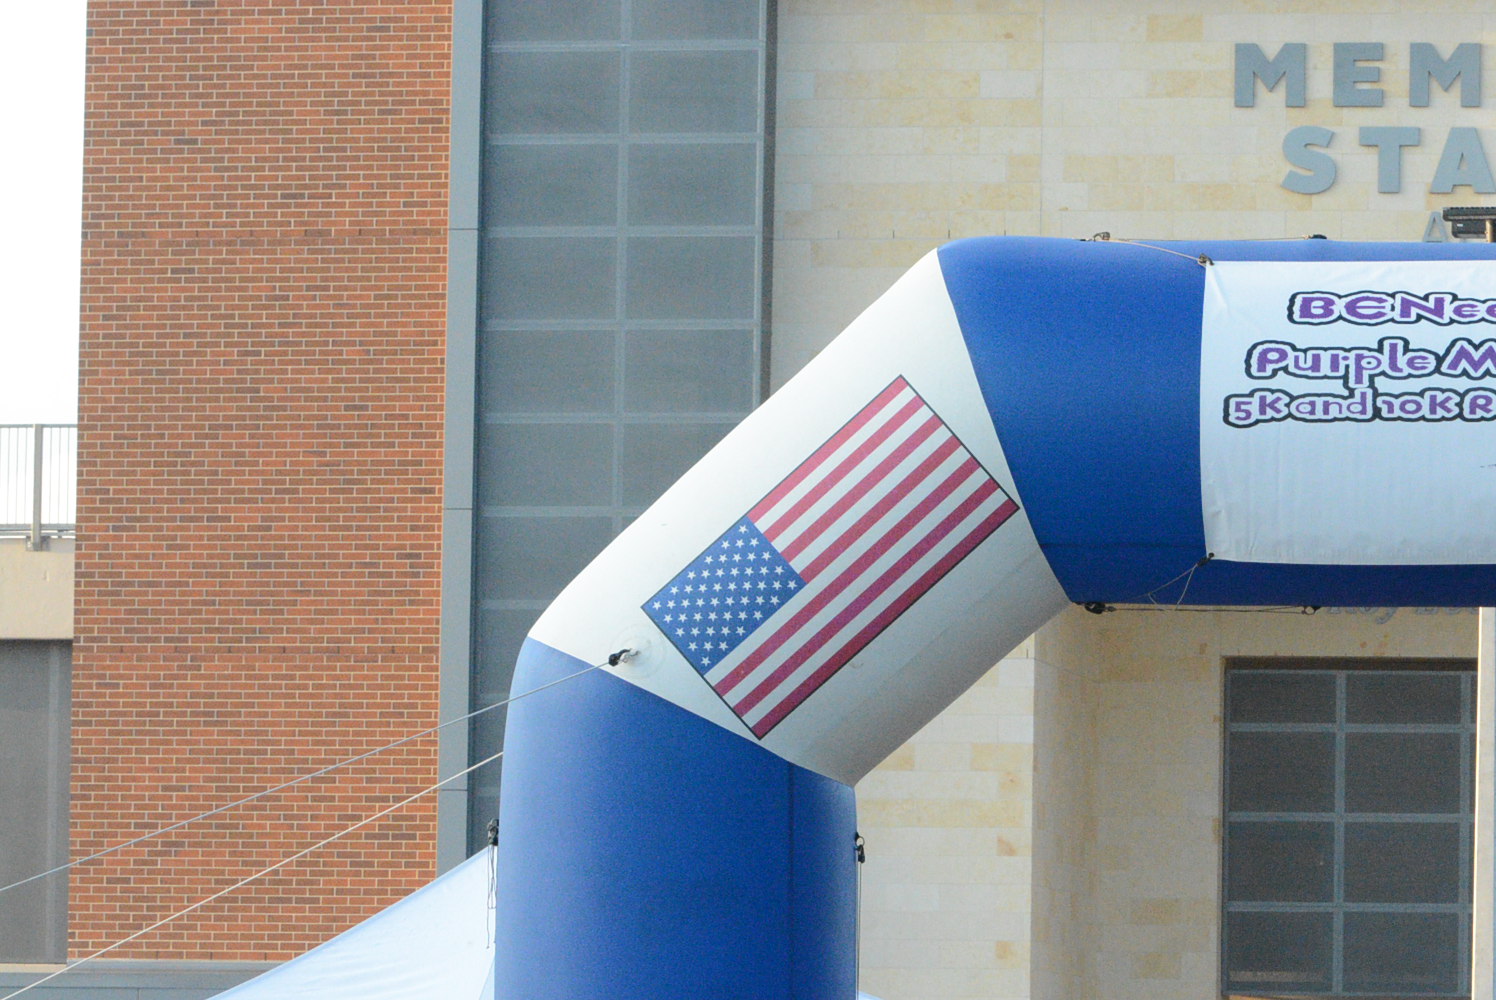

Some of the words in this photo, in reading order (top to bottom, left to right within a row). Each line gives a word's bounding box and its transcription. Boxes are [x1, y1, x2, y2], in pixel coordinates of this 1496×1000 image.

[1252, 341, 1437, 387] Purple
[1231, 393, 1288, 422] 5K
[1291, 389, 1370, 418] and
[1377, 393, 1461, 418] 10K
